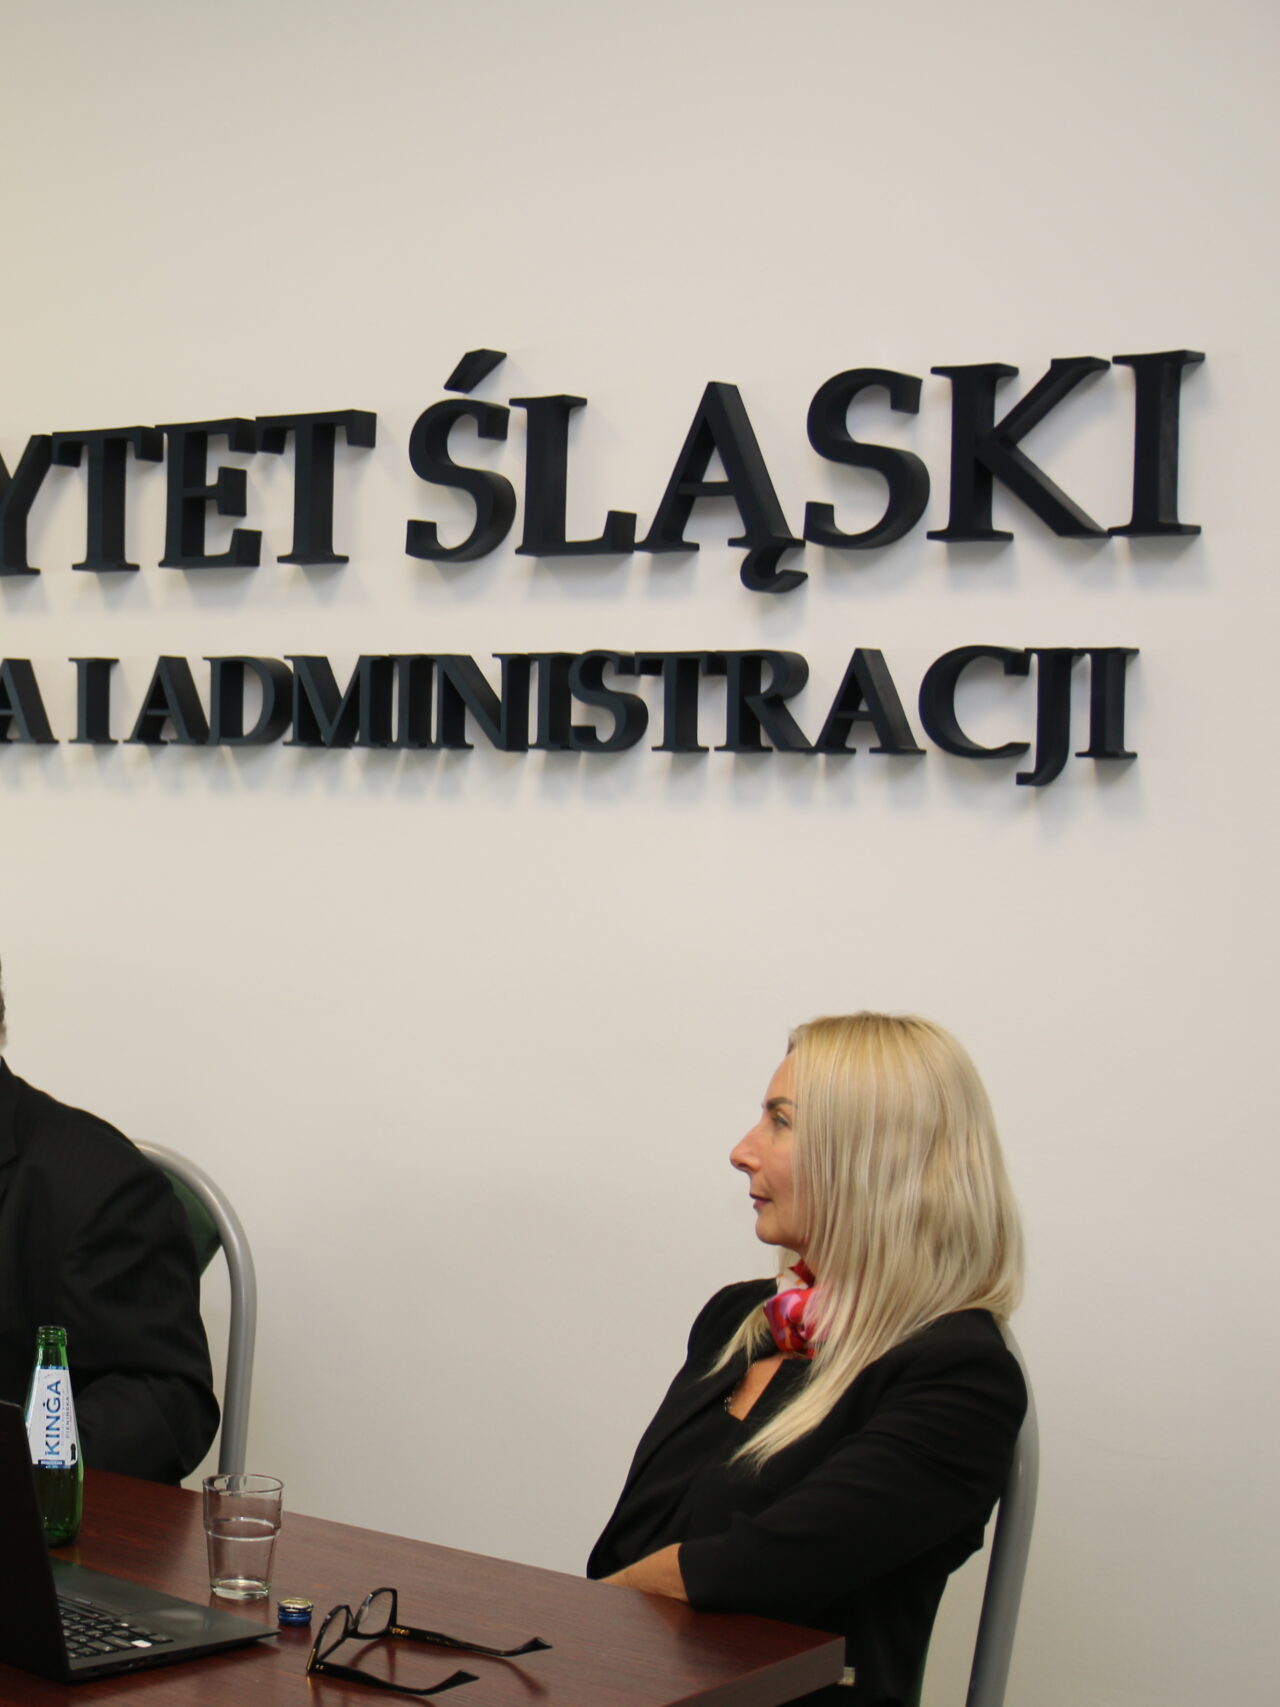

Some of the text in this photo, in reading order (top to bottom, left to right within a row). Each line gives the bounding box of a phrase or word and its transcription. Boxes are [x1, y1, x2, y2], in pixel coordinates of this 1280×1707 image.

[405, 349, 1205, 593] ŚLĄSKI
[68, 656, 119, 748] I
[123, 644, 1139, 786] ADMINISTRACJI
